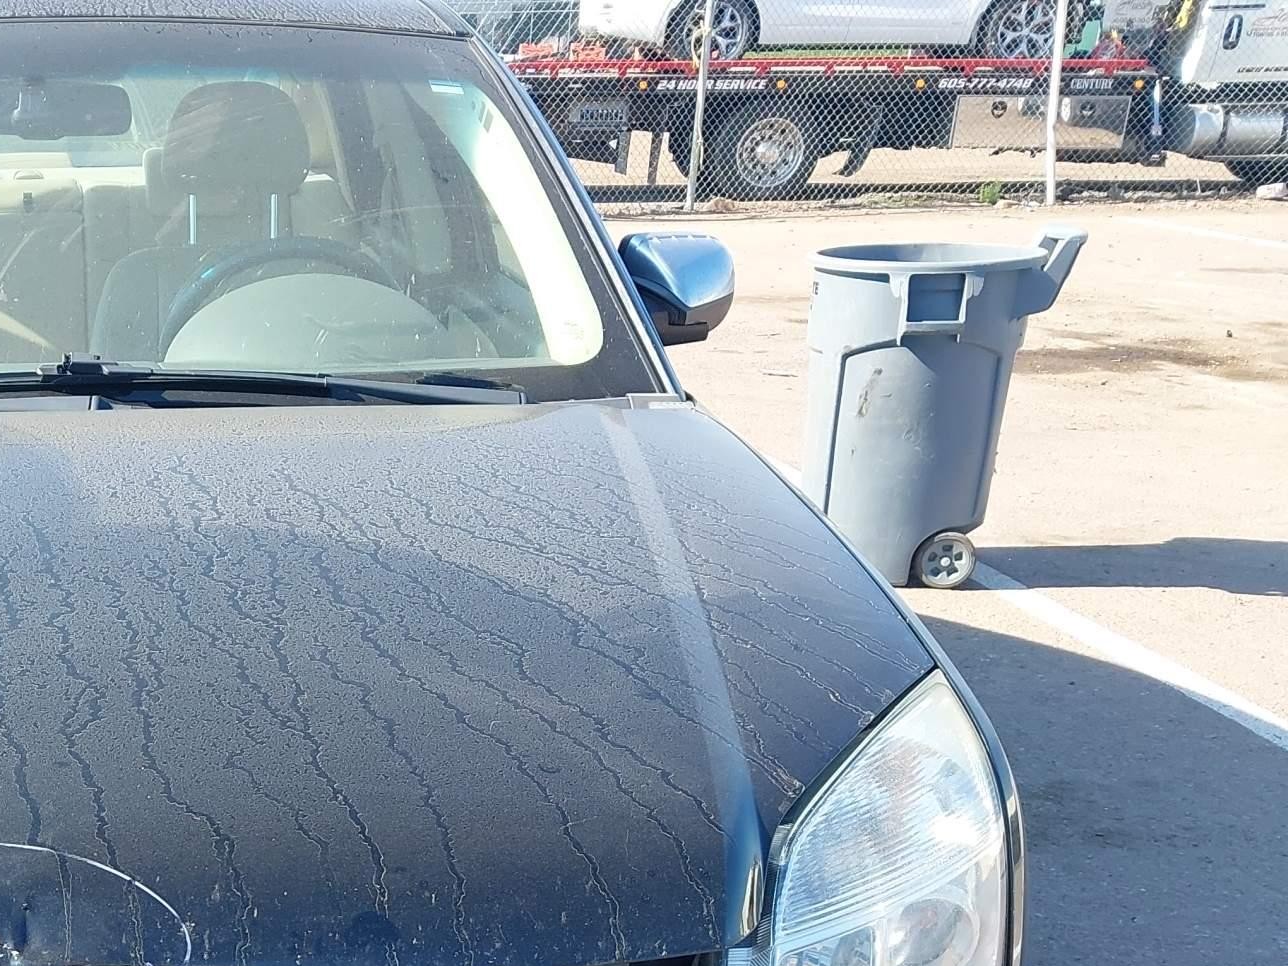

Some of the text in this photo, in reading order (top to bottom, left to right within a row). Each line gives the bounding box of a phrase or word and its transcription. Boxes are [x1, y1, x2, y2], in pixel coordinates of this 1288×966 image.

[657, 79, 768, 90] 24 HOR SERVICE
[938, 78, 1033, 88] 605-777-4748
[1071, 78, 1114, 89] CENTURY
